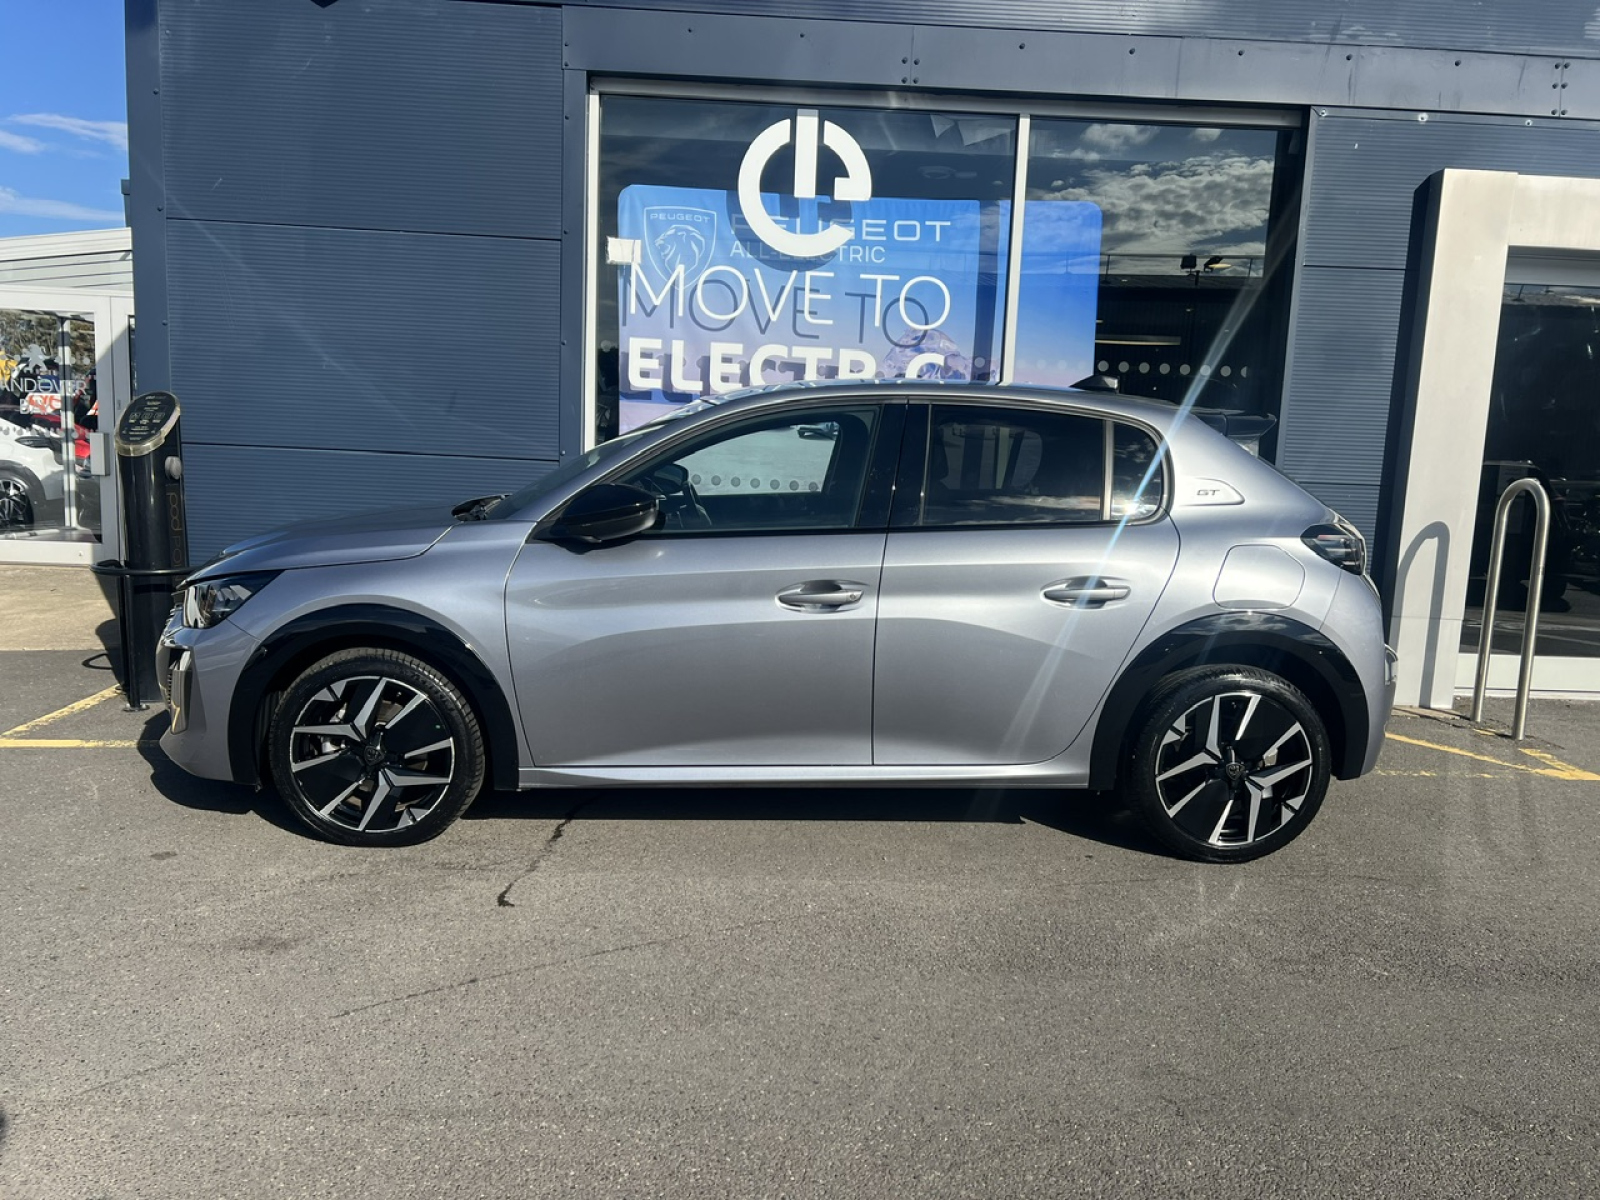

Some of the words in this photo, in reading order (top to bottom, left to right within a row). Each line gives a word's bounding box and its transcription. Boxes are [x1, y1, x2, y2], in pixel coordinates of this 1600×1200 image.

[649, 213, 711, 224] PEUGEOT
[629, 260, 834, 325] MOVE
[859, 273, 951, 331] TO
[627, 337, 945, 392] ELECTRC
[1196, 489, 1221, 497] GT
